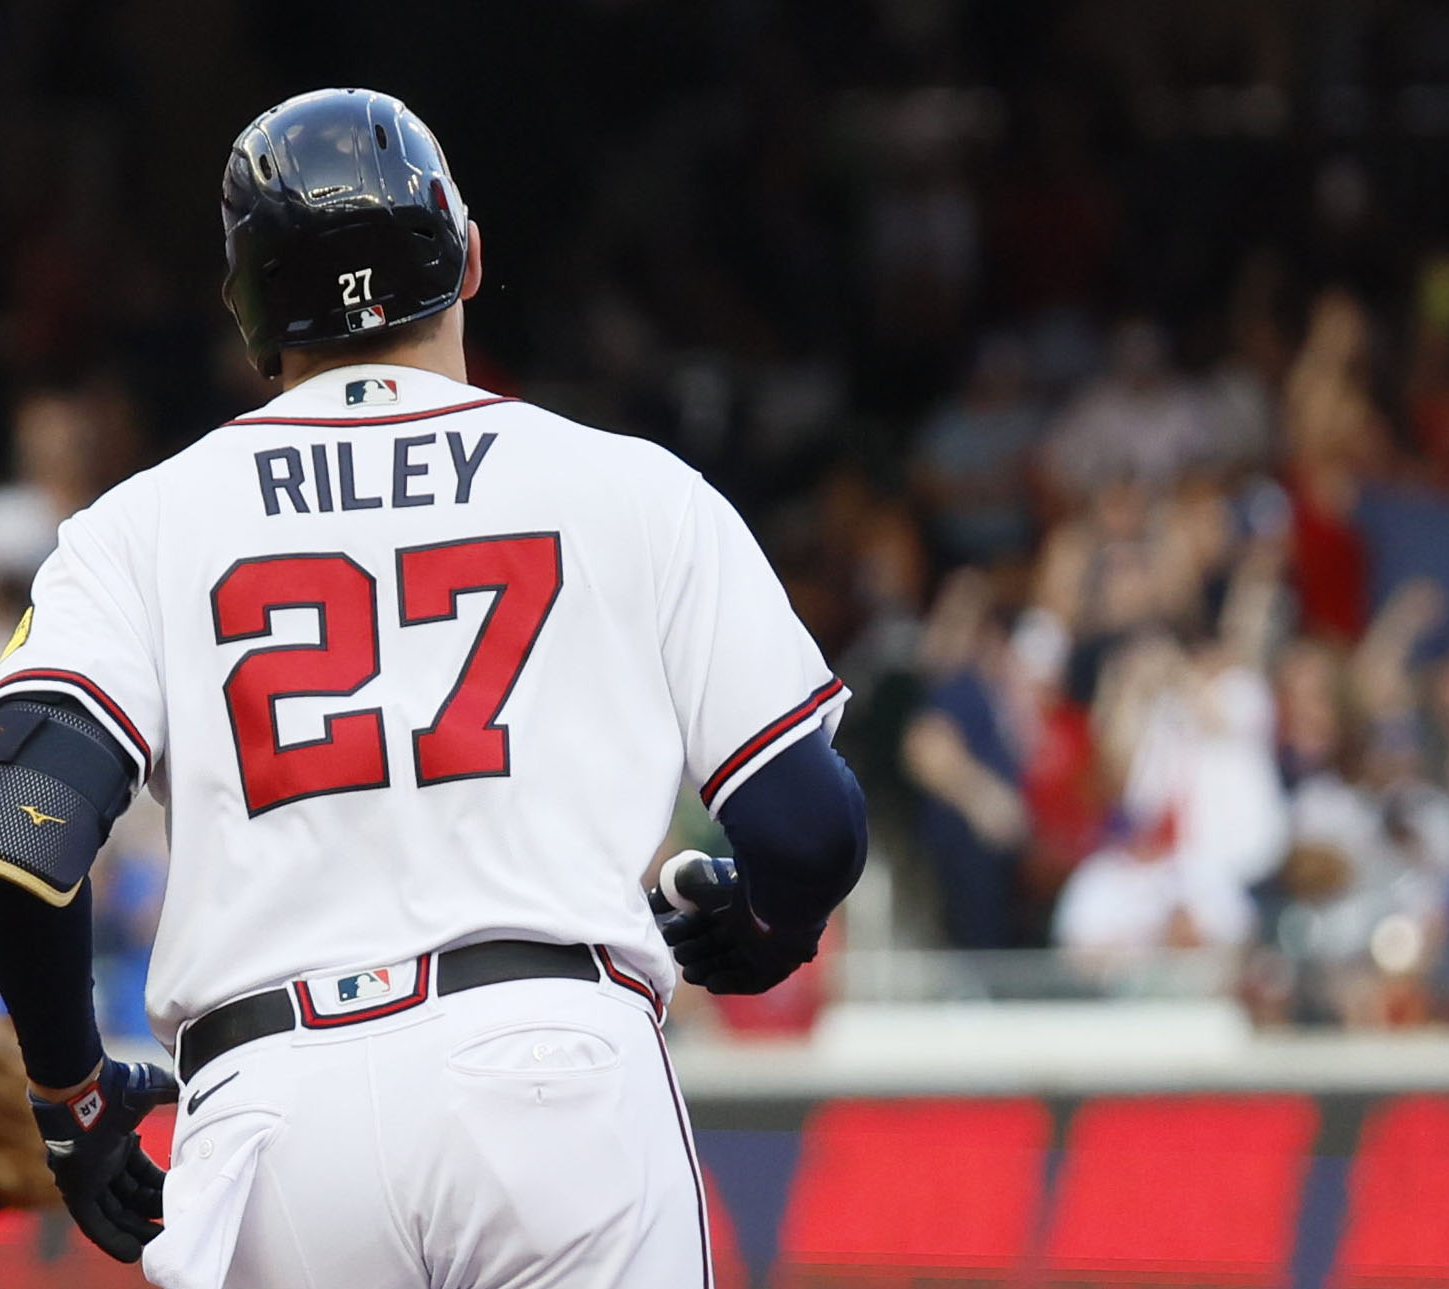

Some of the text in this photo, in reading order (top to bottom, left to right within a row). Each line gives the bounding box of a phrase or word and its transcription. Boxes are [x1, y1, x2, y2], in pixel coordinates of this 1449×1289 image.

[339, 268, 373, 306] 27
[256, 432, 496, 515] RILEY
[212, 531, 563, 817] 27
[80, 1097, 98, 1117] AR
